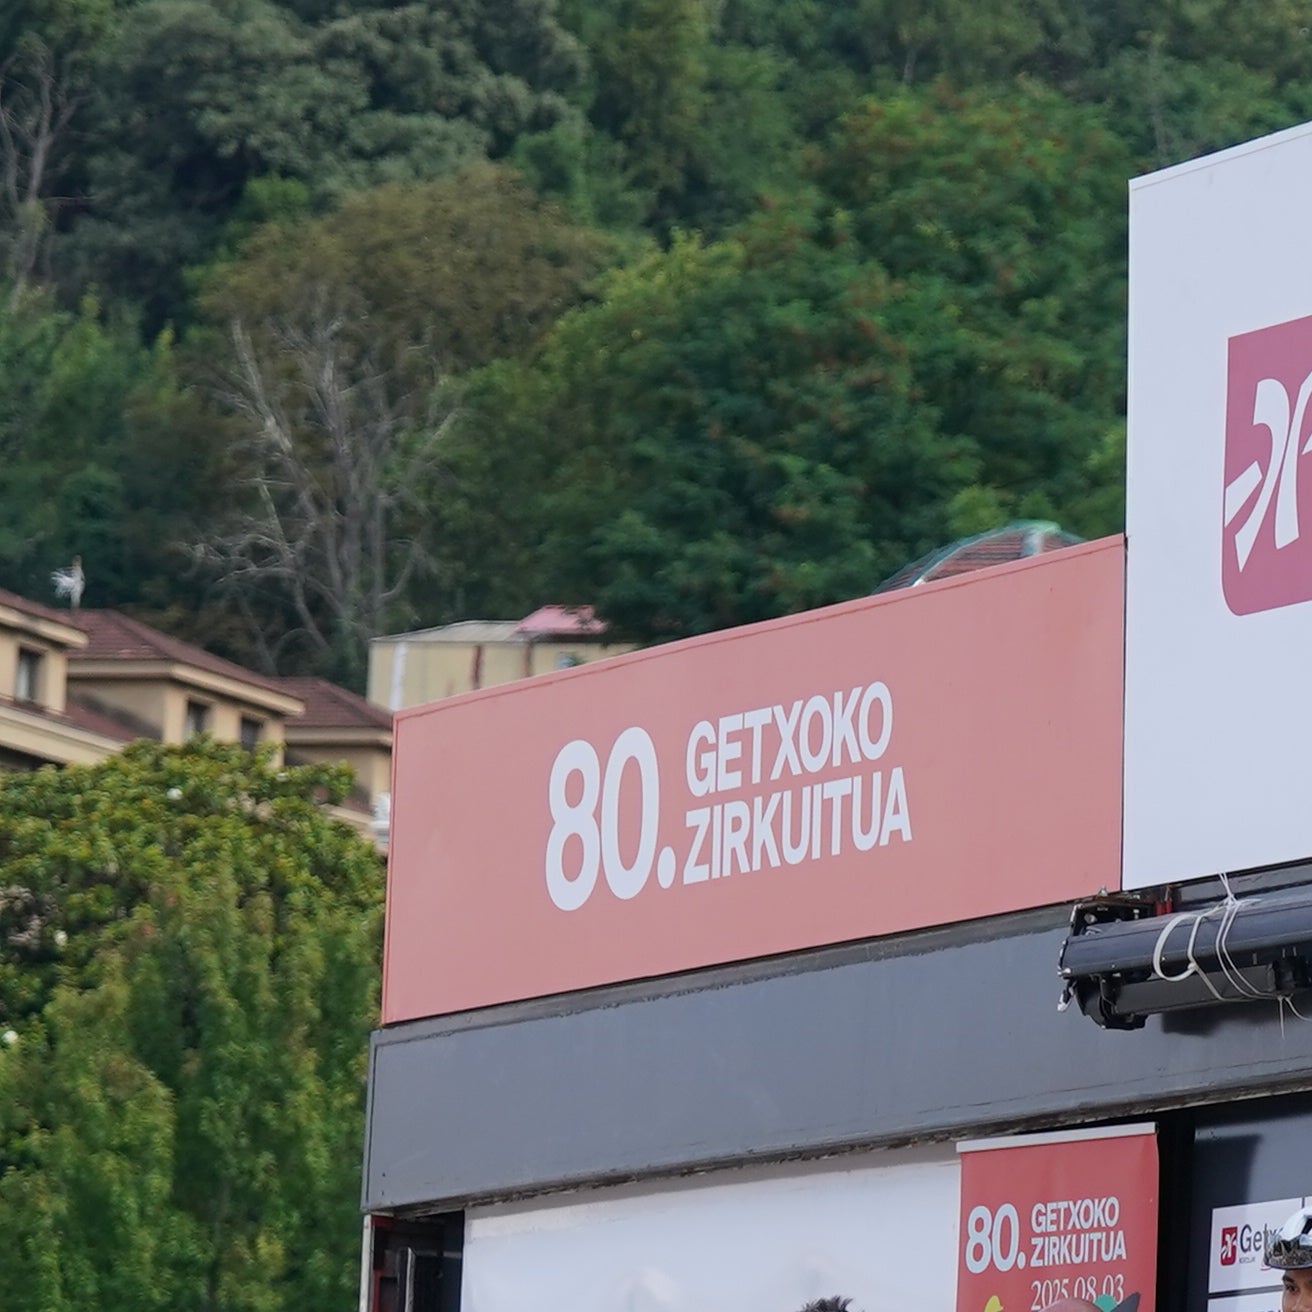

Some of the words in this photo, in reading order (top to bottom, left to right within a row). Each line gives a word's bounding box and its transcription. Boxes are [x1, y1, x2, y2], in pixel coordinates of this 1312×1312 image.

[545, 726, 676, 911] 80.
[685, 681, 894, 796] GETXOKO
[683, 766, 913, 885] ZIRKUITUA
[965, 1203, 1026, 1274] 80.
[1030, 1196, 1120, 1234] GETXOKO
[1030, 1230, 1127, 1268] ZIRKUITUA
